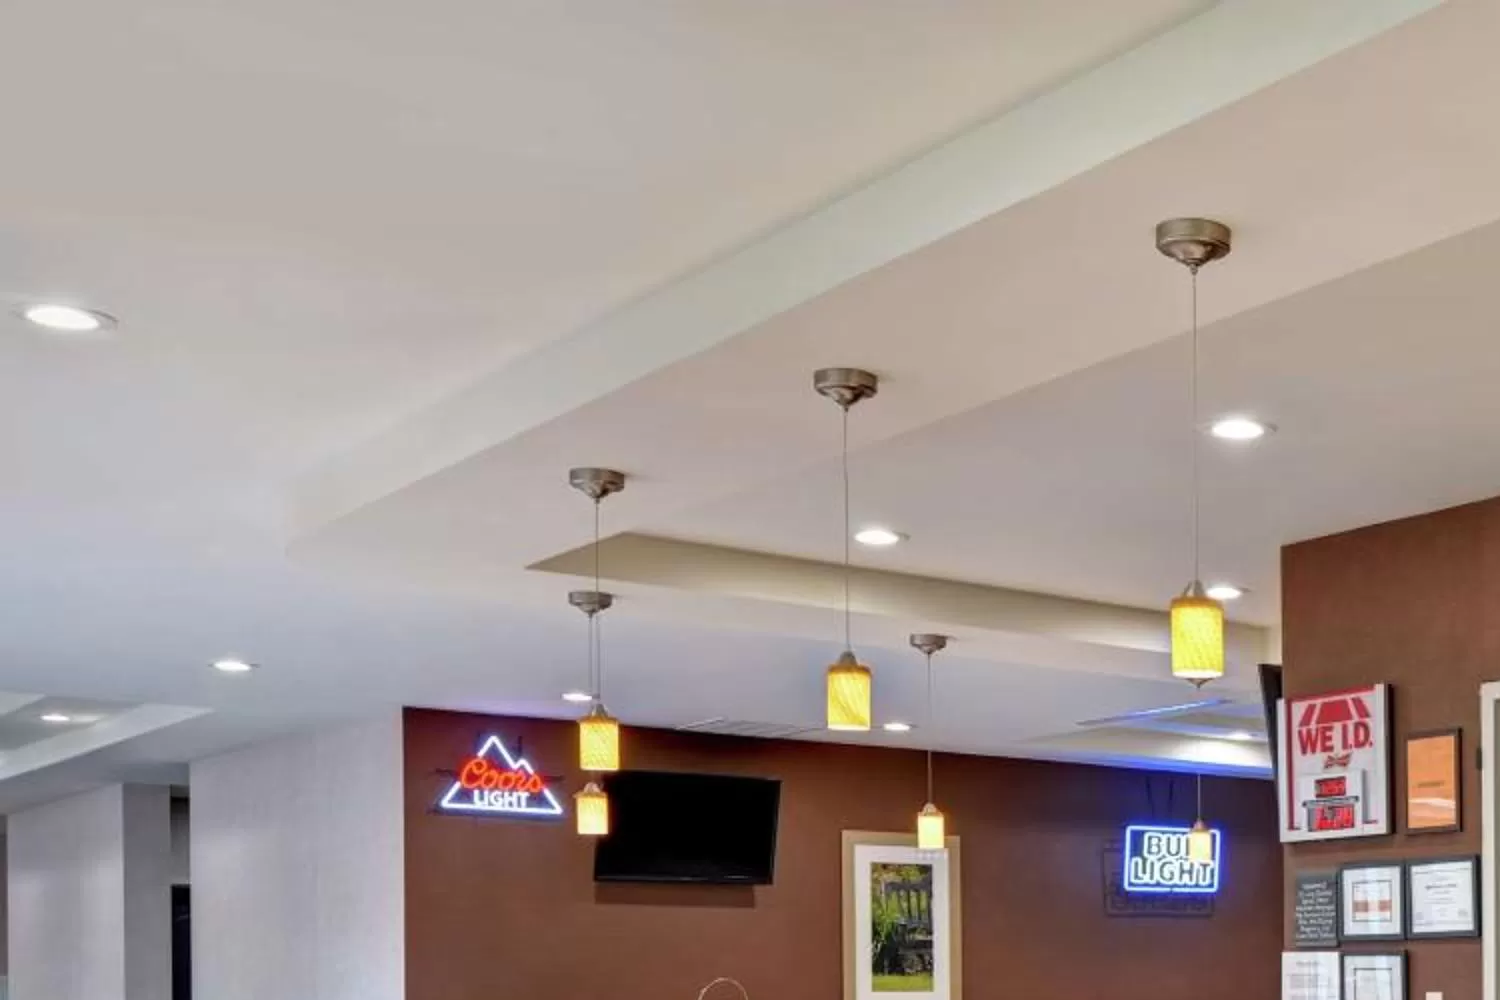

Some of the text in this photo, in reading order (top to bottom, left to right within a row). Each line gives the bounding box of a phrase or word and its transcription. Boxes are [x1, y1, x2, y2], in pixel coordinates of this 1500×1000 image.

[1297, 721, 1373, 755] WE I.D.
[461, 758, 543, 793] Coors
[473, 790, 531, 808] LIGHT
[1131, 857, 1212, 885] LIGHT
